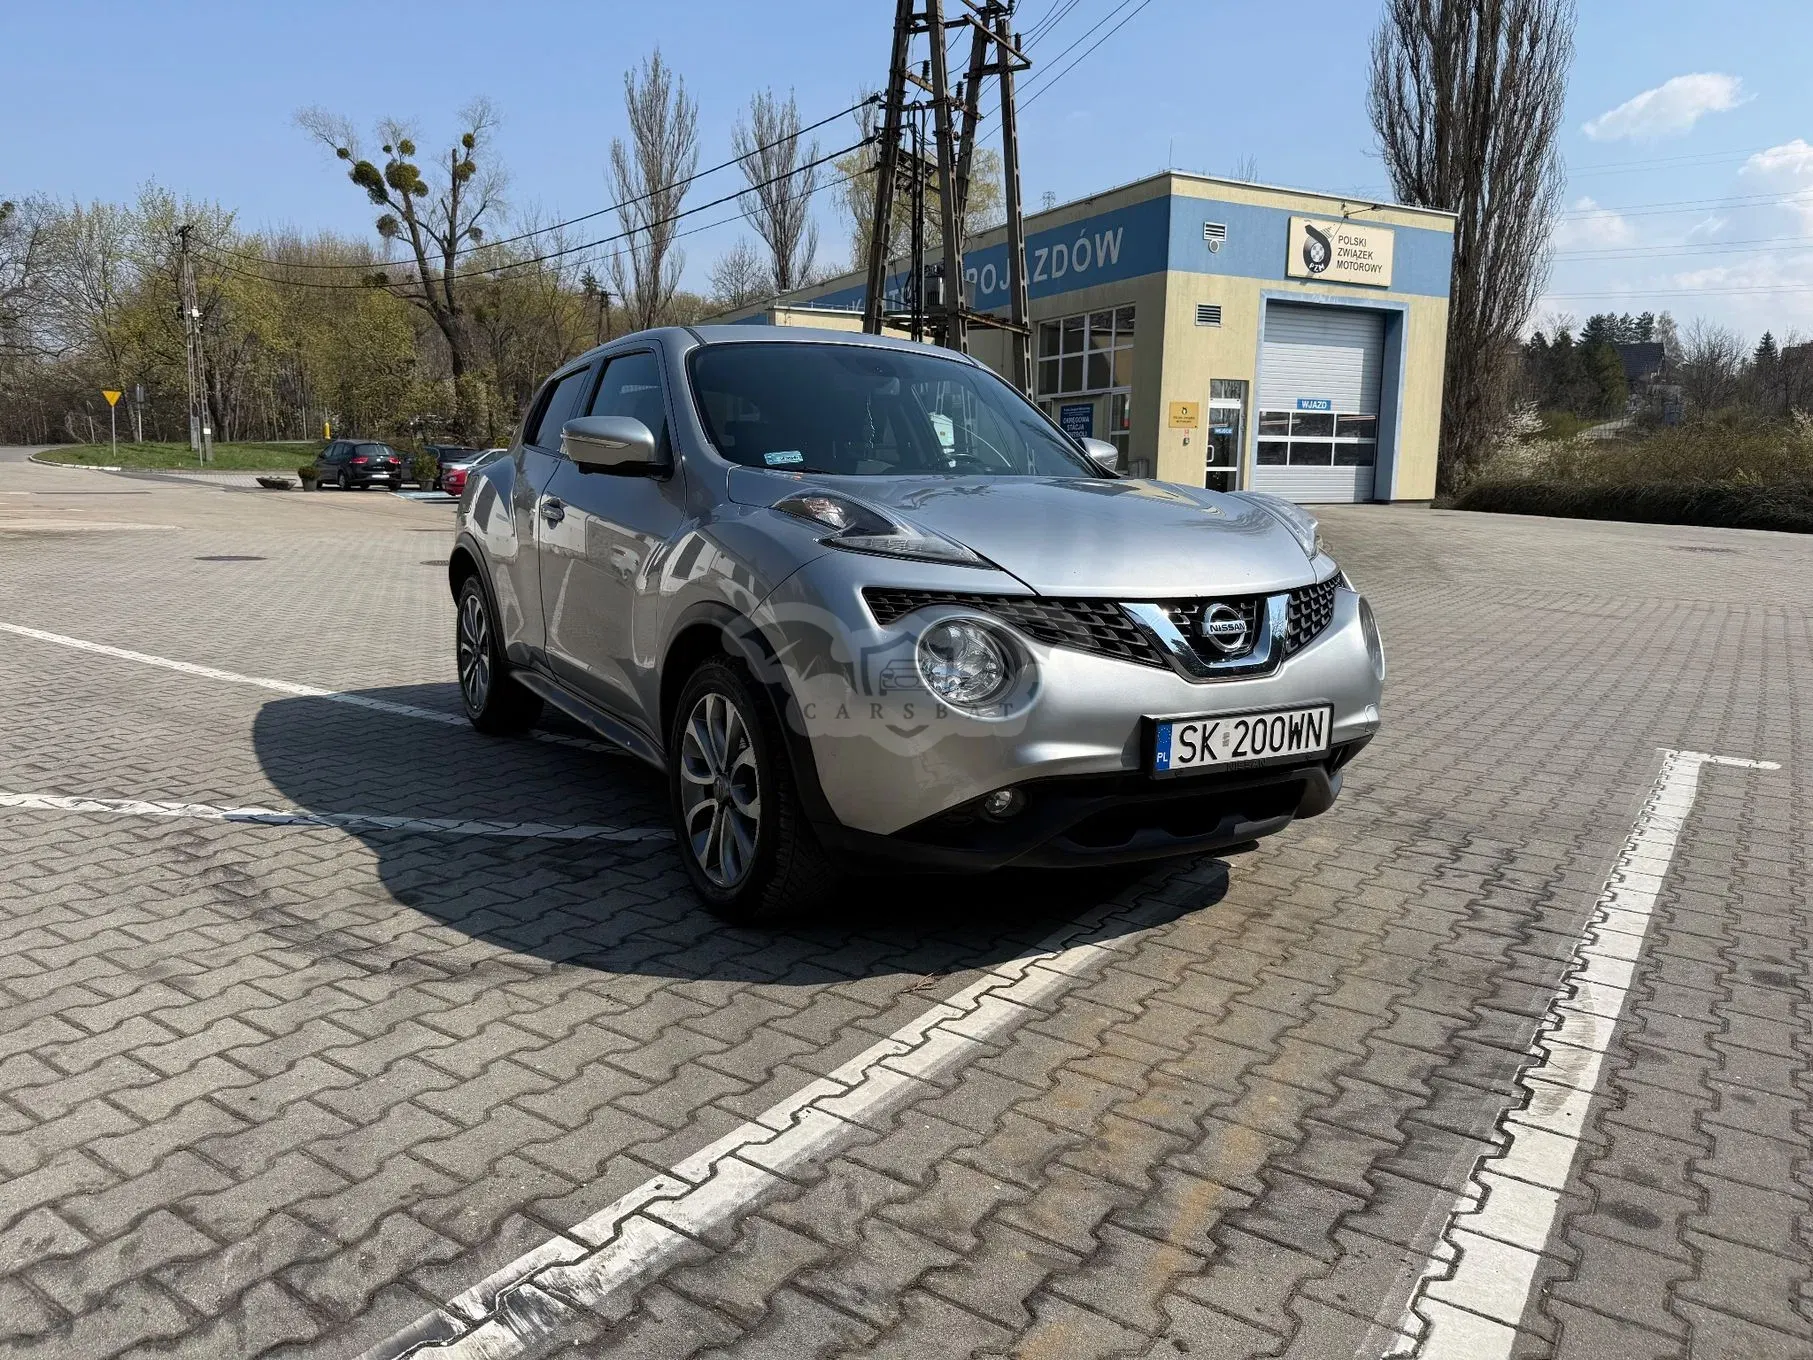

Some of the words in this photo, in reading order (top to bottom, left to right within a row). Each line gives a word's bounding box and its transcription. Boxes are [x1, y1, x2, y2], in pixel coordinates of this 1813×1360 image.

[1338, 235, 1366, 247] POLSKI
[1337, 248, 1373, 260] ZWIĄZEK
[966, 227, 1123, 294] POJZDÓW
[1336, 260, 1382, 273] MOTOROWY
[1308, 262, 1325, 272] PZM
[1301, 400, 1327, 409] WJAZD
[1209, 621, 1246, 633] NISSAN
[1178, 722, 1220, 763] SK
[1231, 711, 1324, 758] 200WN
[1156, 752, 1168, 763] PL
